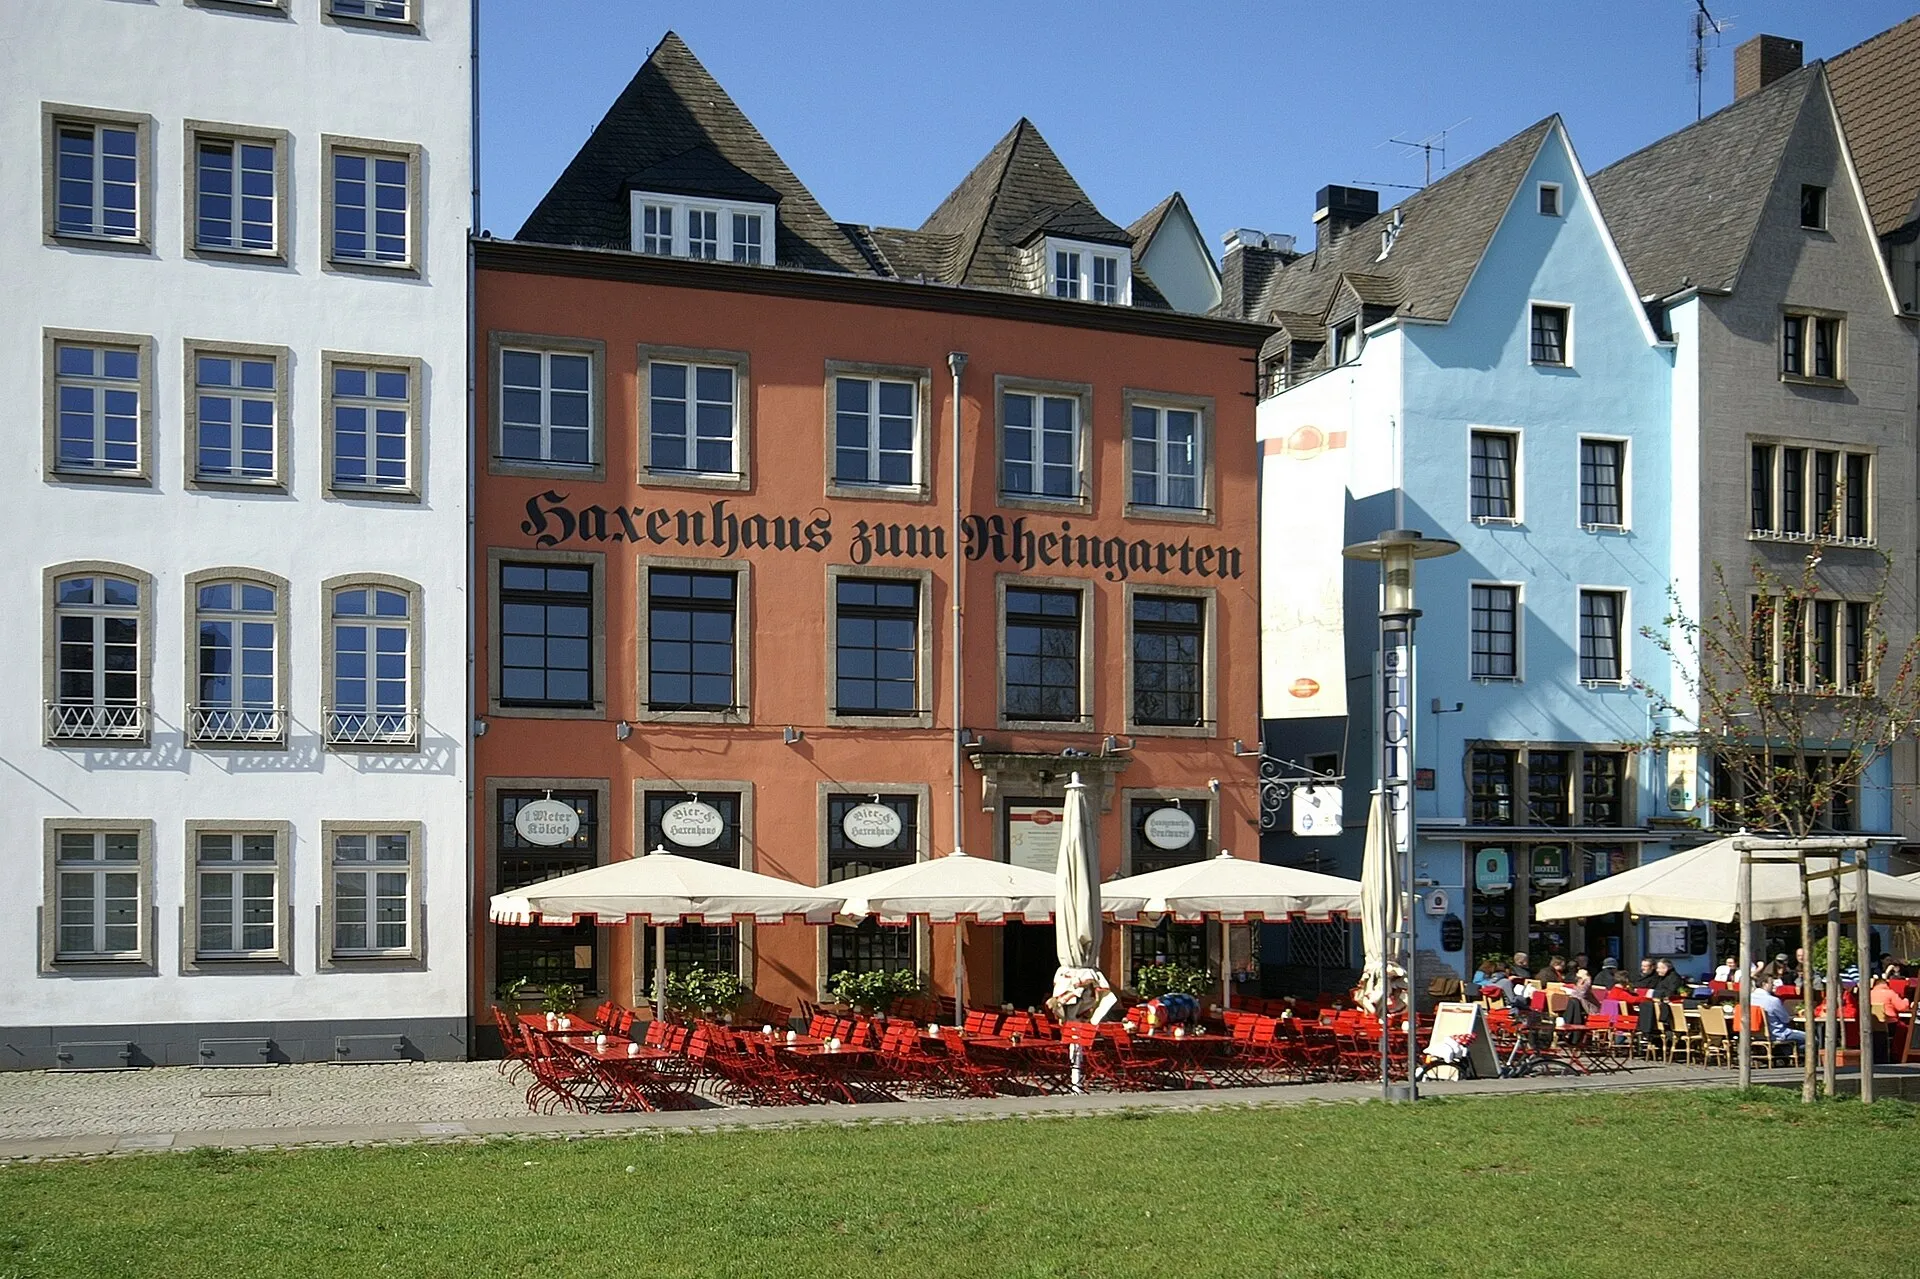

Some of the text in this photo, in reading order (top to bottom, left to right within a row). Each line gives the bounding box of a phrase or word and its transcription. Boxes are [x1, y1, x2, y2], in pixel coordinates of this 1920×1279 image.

[521, 490, 1246, 582] Haxenhaus zum Rheingarten
[533, 810, 572, 822] Meter
[527, 822, 570, 836] Kölsch
[670, 824, 717, 836] Haxenhaus
